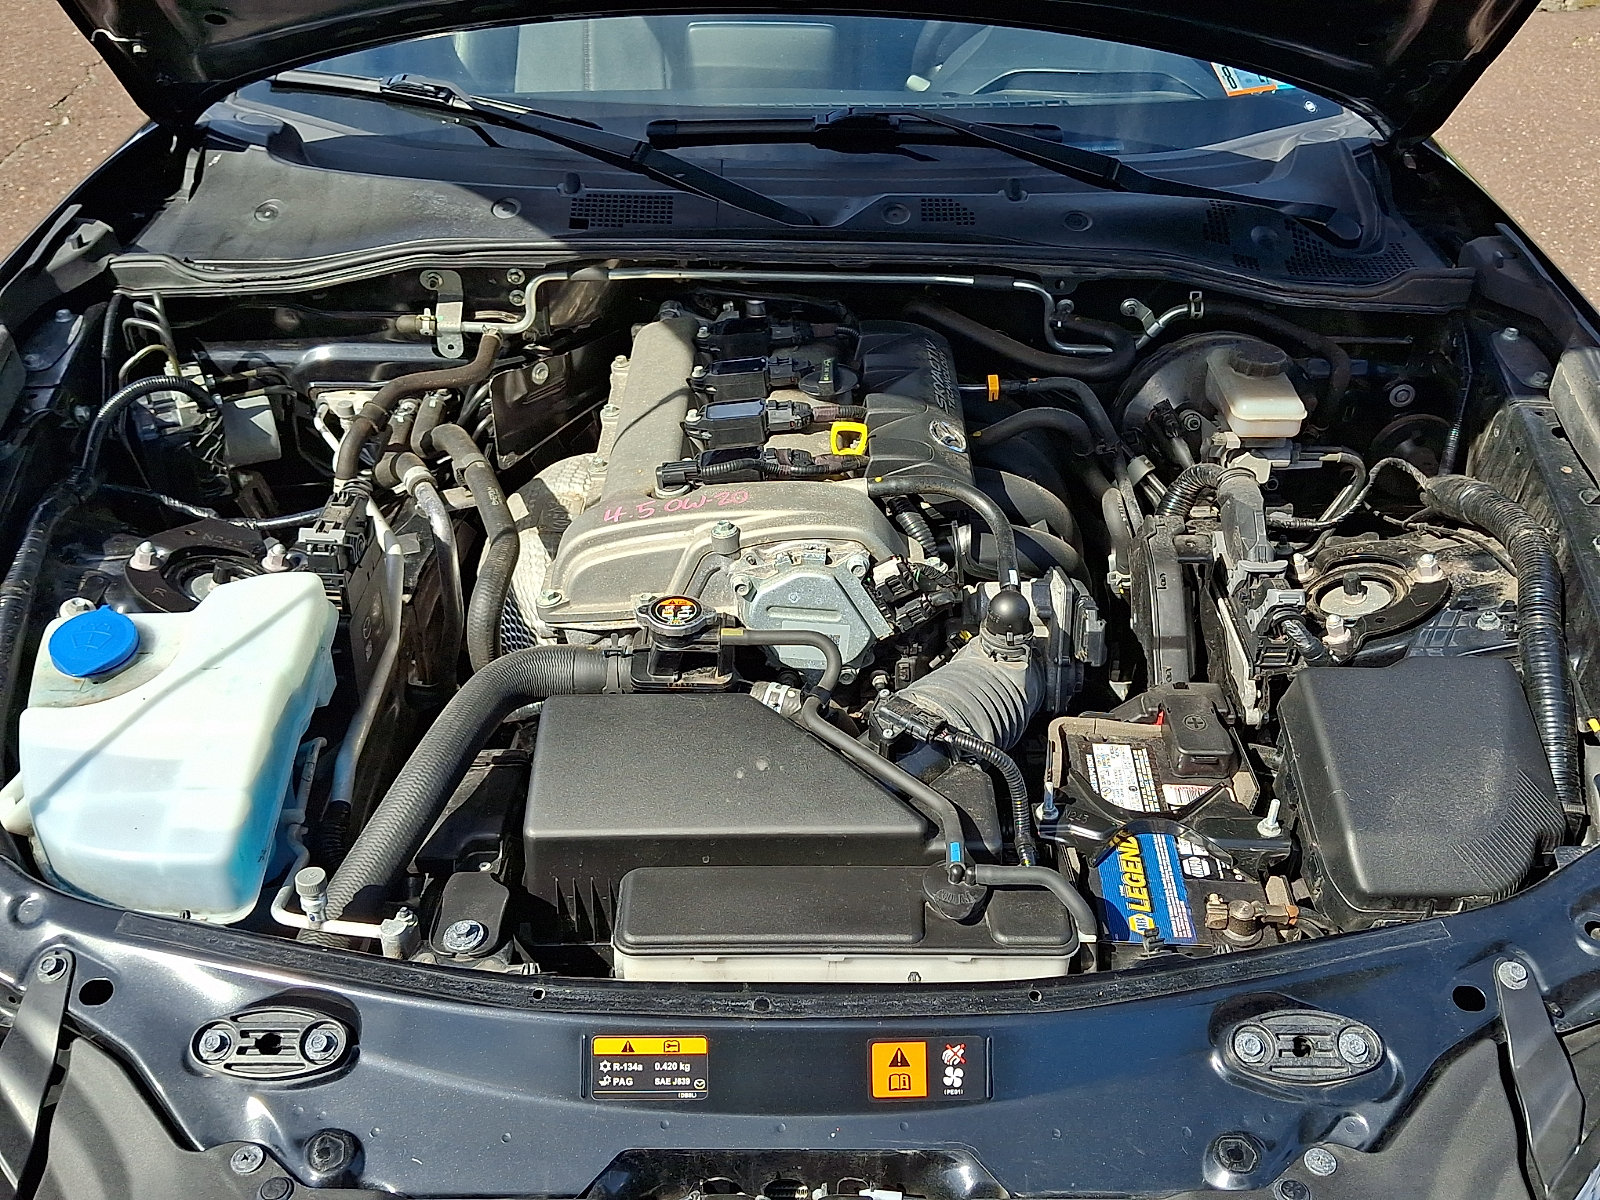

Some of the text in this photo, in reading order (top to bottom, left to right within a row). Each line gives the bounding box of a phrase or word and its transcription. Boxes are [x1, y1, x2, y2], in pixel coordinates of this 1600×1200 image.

[925, 338, 950, 415] SKYACTIV
[603, 500, 656, 523] 4.5
[1117, 832, 1153, 913] LEGEND
[612, 1062, 691, 1073] R-134a 0.420 kg
[612, 1077, 634, 1086] PAG
[654, 1077, 671, 1085] SAE
